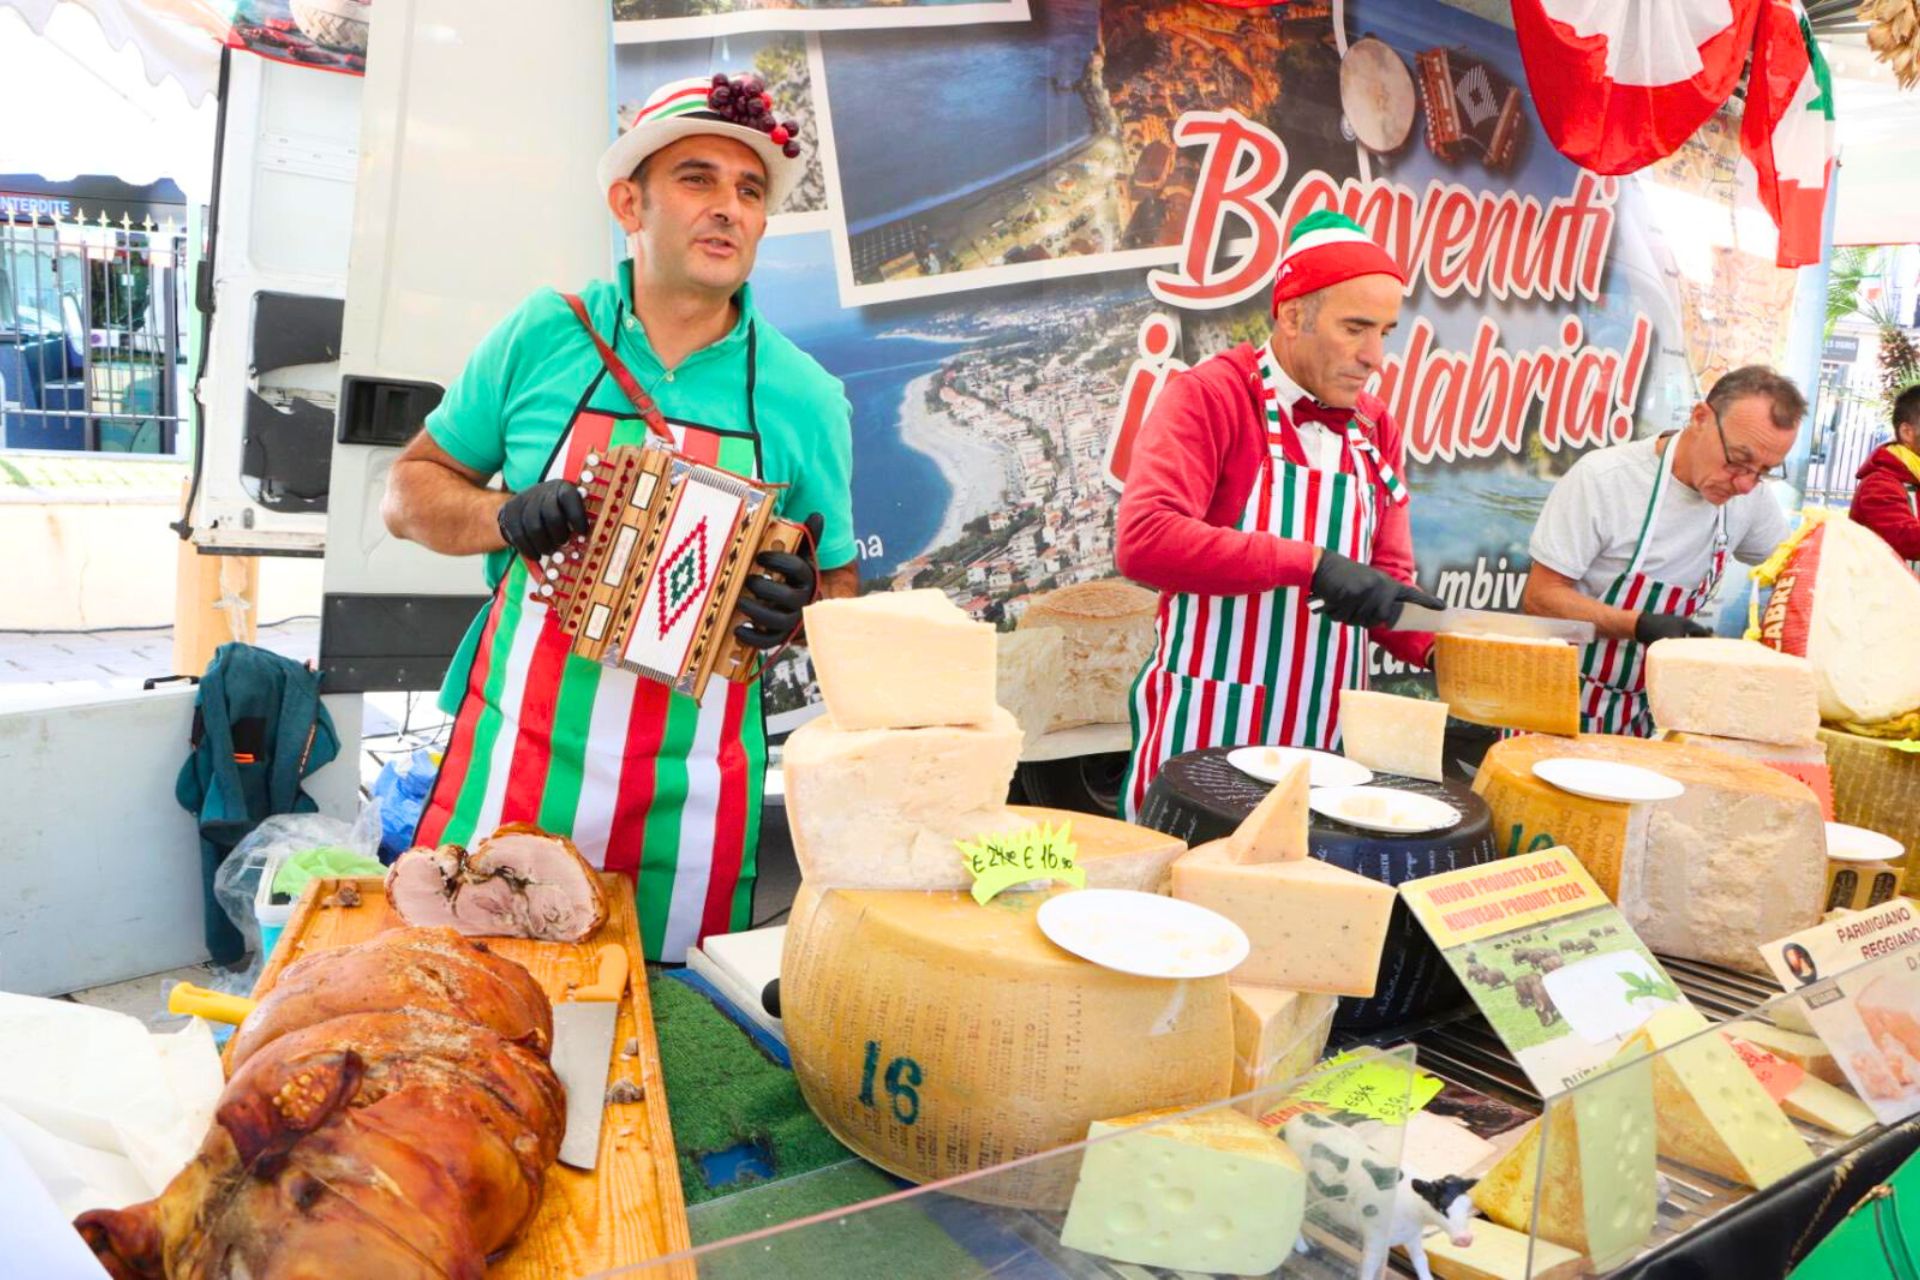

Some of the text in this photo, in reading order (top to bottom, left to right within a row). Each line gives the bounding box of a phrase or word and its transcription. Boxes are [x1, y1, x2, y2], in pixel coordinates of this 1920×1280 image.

[1427, 859, 1568, 907] NUOVO PRODOTTO 2024
[1442, 882, 1587, 932] NOUVEAU PRODUIT 2024
[1836, 907, 1911, 943] PARMIGIANO
[1860, 927, 1920, 960] REGGIANO
[858, 1040, 923, 1125] 16
